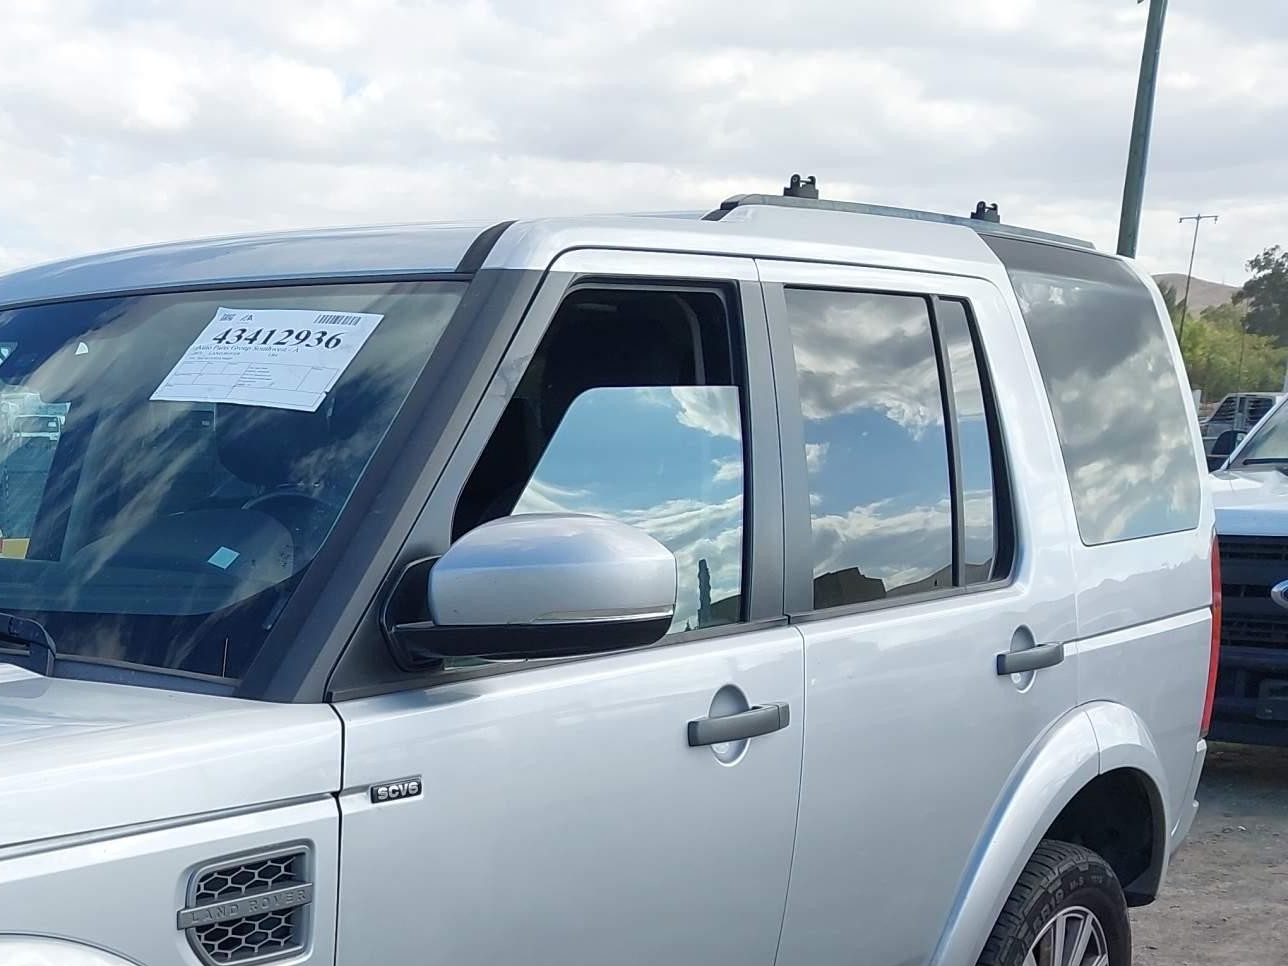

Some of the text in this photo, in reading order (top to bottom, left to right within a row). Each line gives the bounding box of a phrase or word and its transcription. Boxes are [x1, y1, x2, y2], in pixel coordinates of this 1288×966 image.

[212, 328, 344, 349] 43412936
[377, 782, 419, 800] SCV6
[190, 889, 308, 925] LAND ROVER
